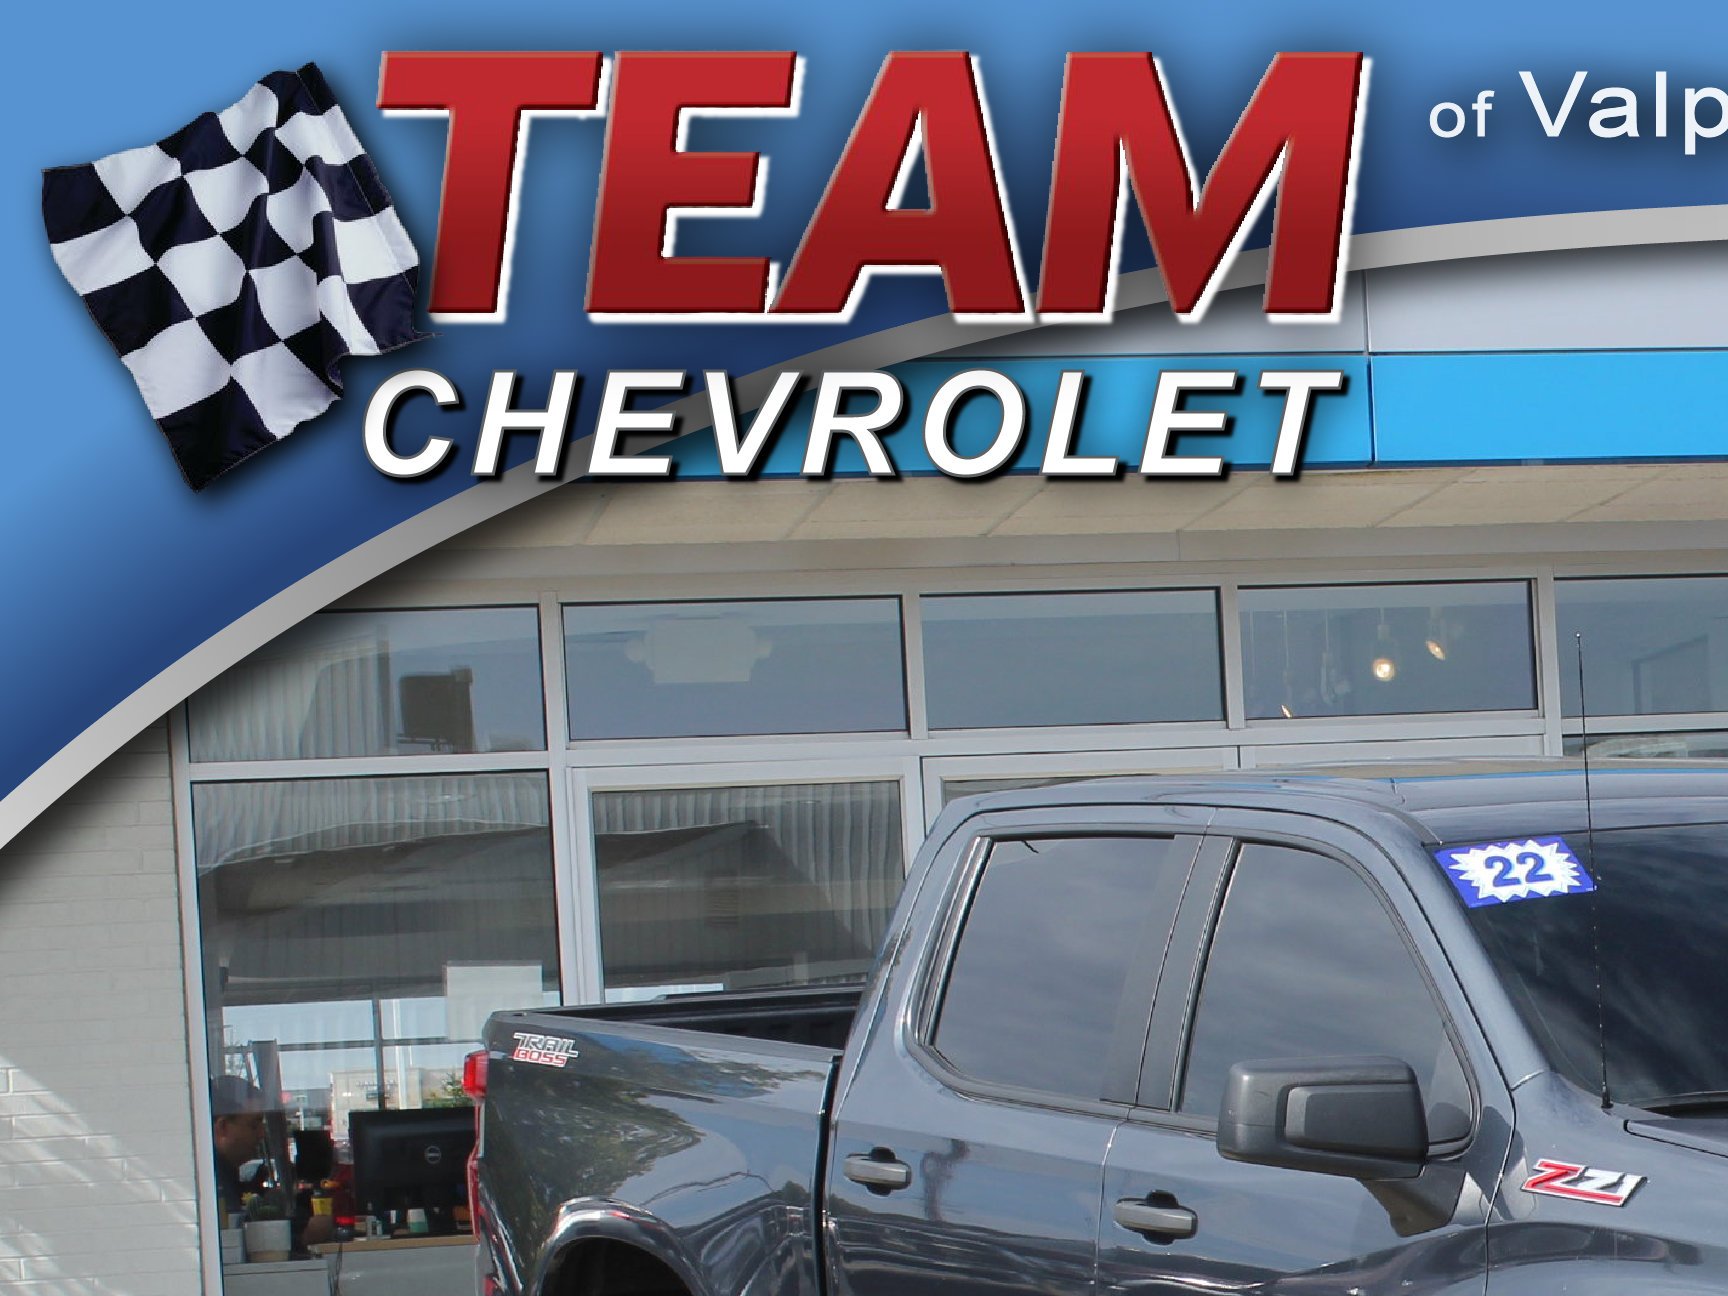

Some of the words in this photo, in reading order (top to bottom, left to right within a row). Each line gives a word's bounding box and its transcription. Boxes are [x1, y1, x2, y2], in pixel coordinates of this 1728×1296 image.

[1484, 851, 1555, 888] 22
[513, 1032, 580, 1058] TRAIL
[513, 1047, 568, 1068] BOSS
[1520, 1158, 1647, 1207] Z71
